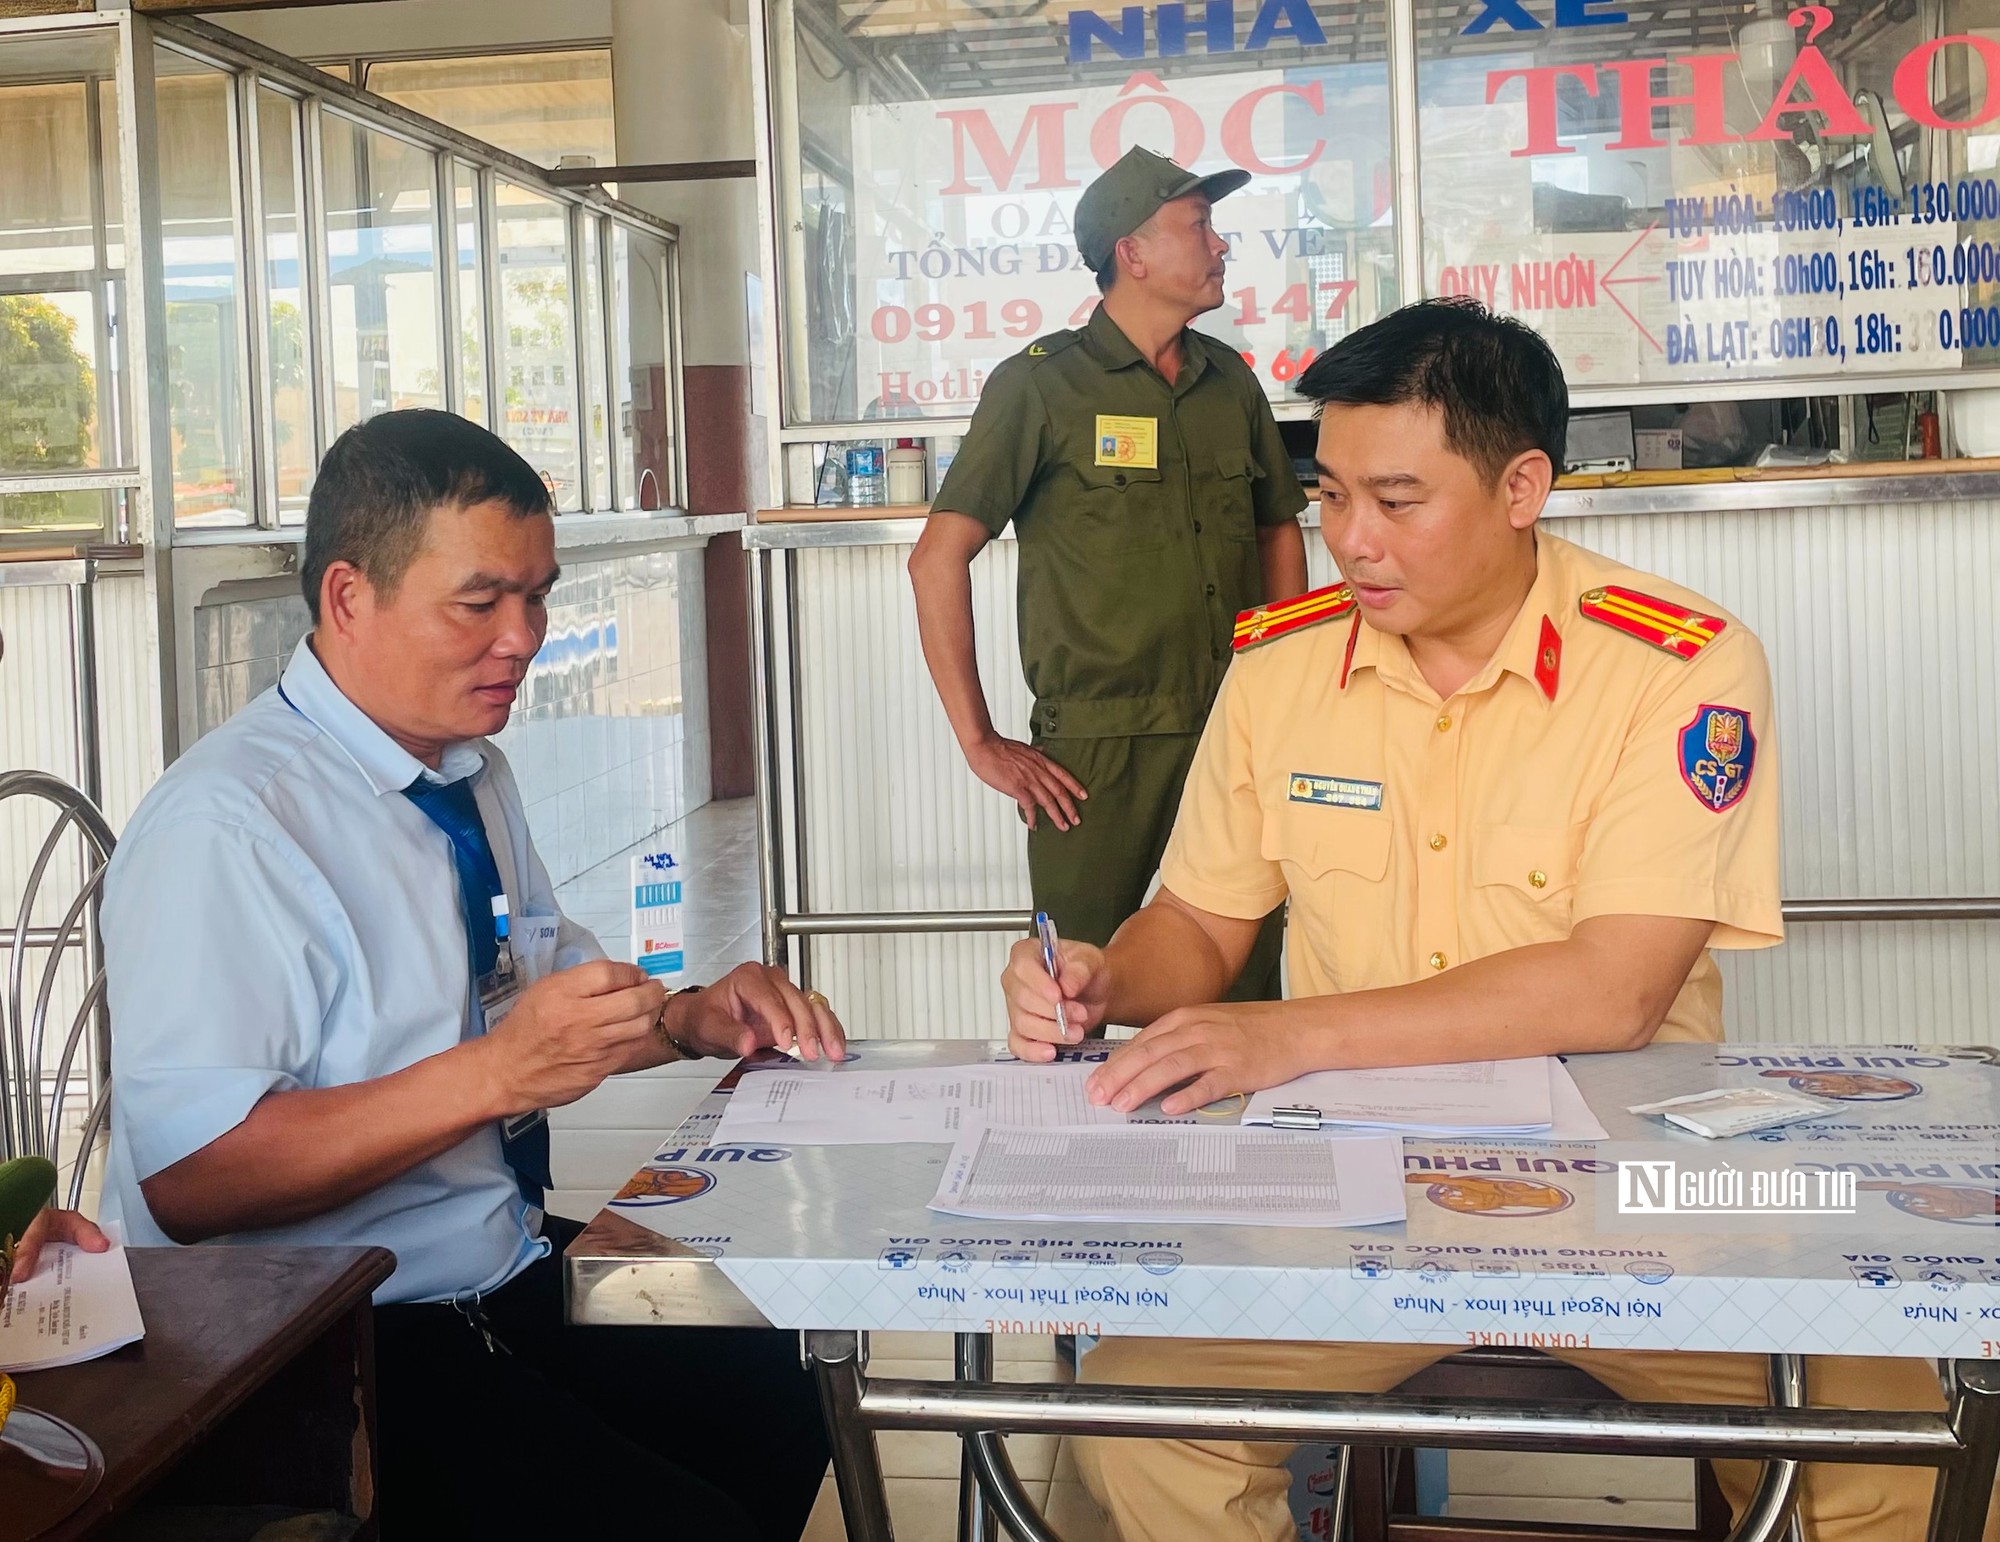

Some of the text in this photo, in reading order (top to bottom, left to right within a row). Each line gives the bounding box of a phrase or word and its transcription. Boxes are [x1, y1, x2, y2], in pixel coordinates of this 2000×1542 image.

[1665, 196, 1705, 239] TUY
[1713, 183, 1763, 236] HÒA:
[1911, 179, 2000, 224] 130.000
[888, 231, 1023, 280] TỔNG
[1511, 252, 1597, 311] NHƠN
[1666, 260, 1706, 303] TUY
[1714, 247, 1764, 299] HÒA:
[871, 298, 1043, 343] 0919
[1232, 280, 1360, 326] 147
[1666, 314, 1699, 365] ĐÀ
[1706, 320, 1758, 369] LẠT:
[1854, 313, 1902, 354] 18h:
[877, 368, 984, 407] Hotli
[1695, 759, 1744, 780] CS GT
[694, 1148, 793, 1162] QUI
[1404, 1155, 1620, 1173] QUI PHU
[889, 1237, 931, 1245] GIA
[1060, 1252, 1114, 1260] 1985
[1842, 1254, 1892, 1262] GIA
[918, 1283, 965, 1303] Nhựa
[984, 1288, 1024, 1304] Inox
[1030, 1289, 1069, 1306] Thất
[1075, 1286, 1130, 1306] Ngoại
[1137, 1288, 1168, 1307] Nội
[1393, 1294, 1444, 1313] Nhựa
[1465, 1299, 1507, 1315] Inox
[1514, 1299, 1556, 1318] Thất
[1562, 1296, 1620, 1317] Ngoại
[1627, 1298, 1662, 1318] Nội
[1903, 1302, 1958, 1322] Nhựa
[985, 1319, 1101, 1335] FURNITURE
[1466, 1331, 1590, 1349] FURNITURE
